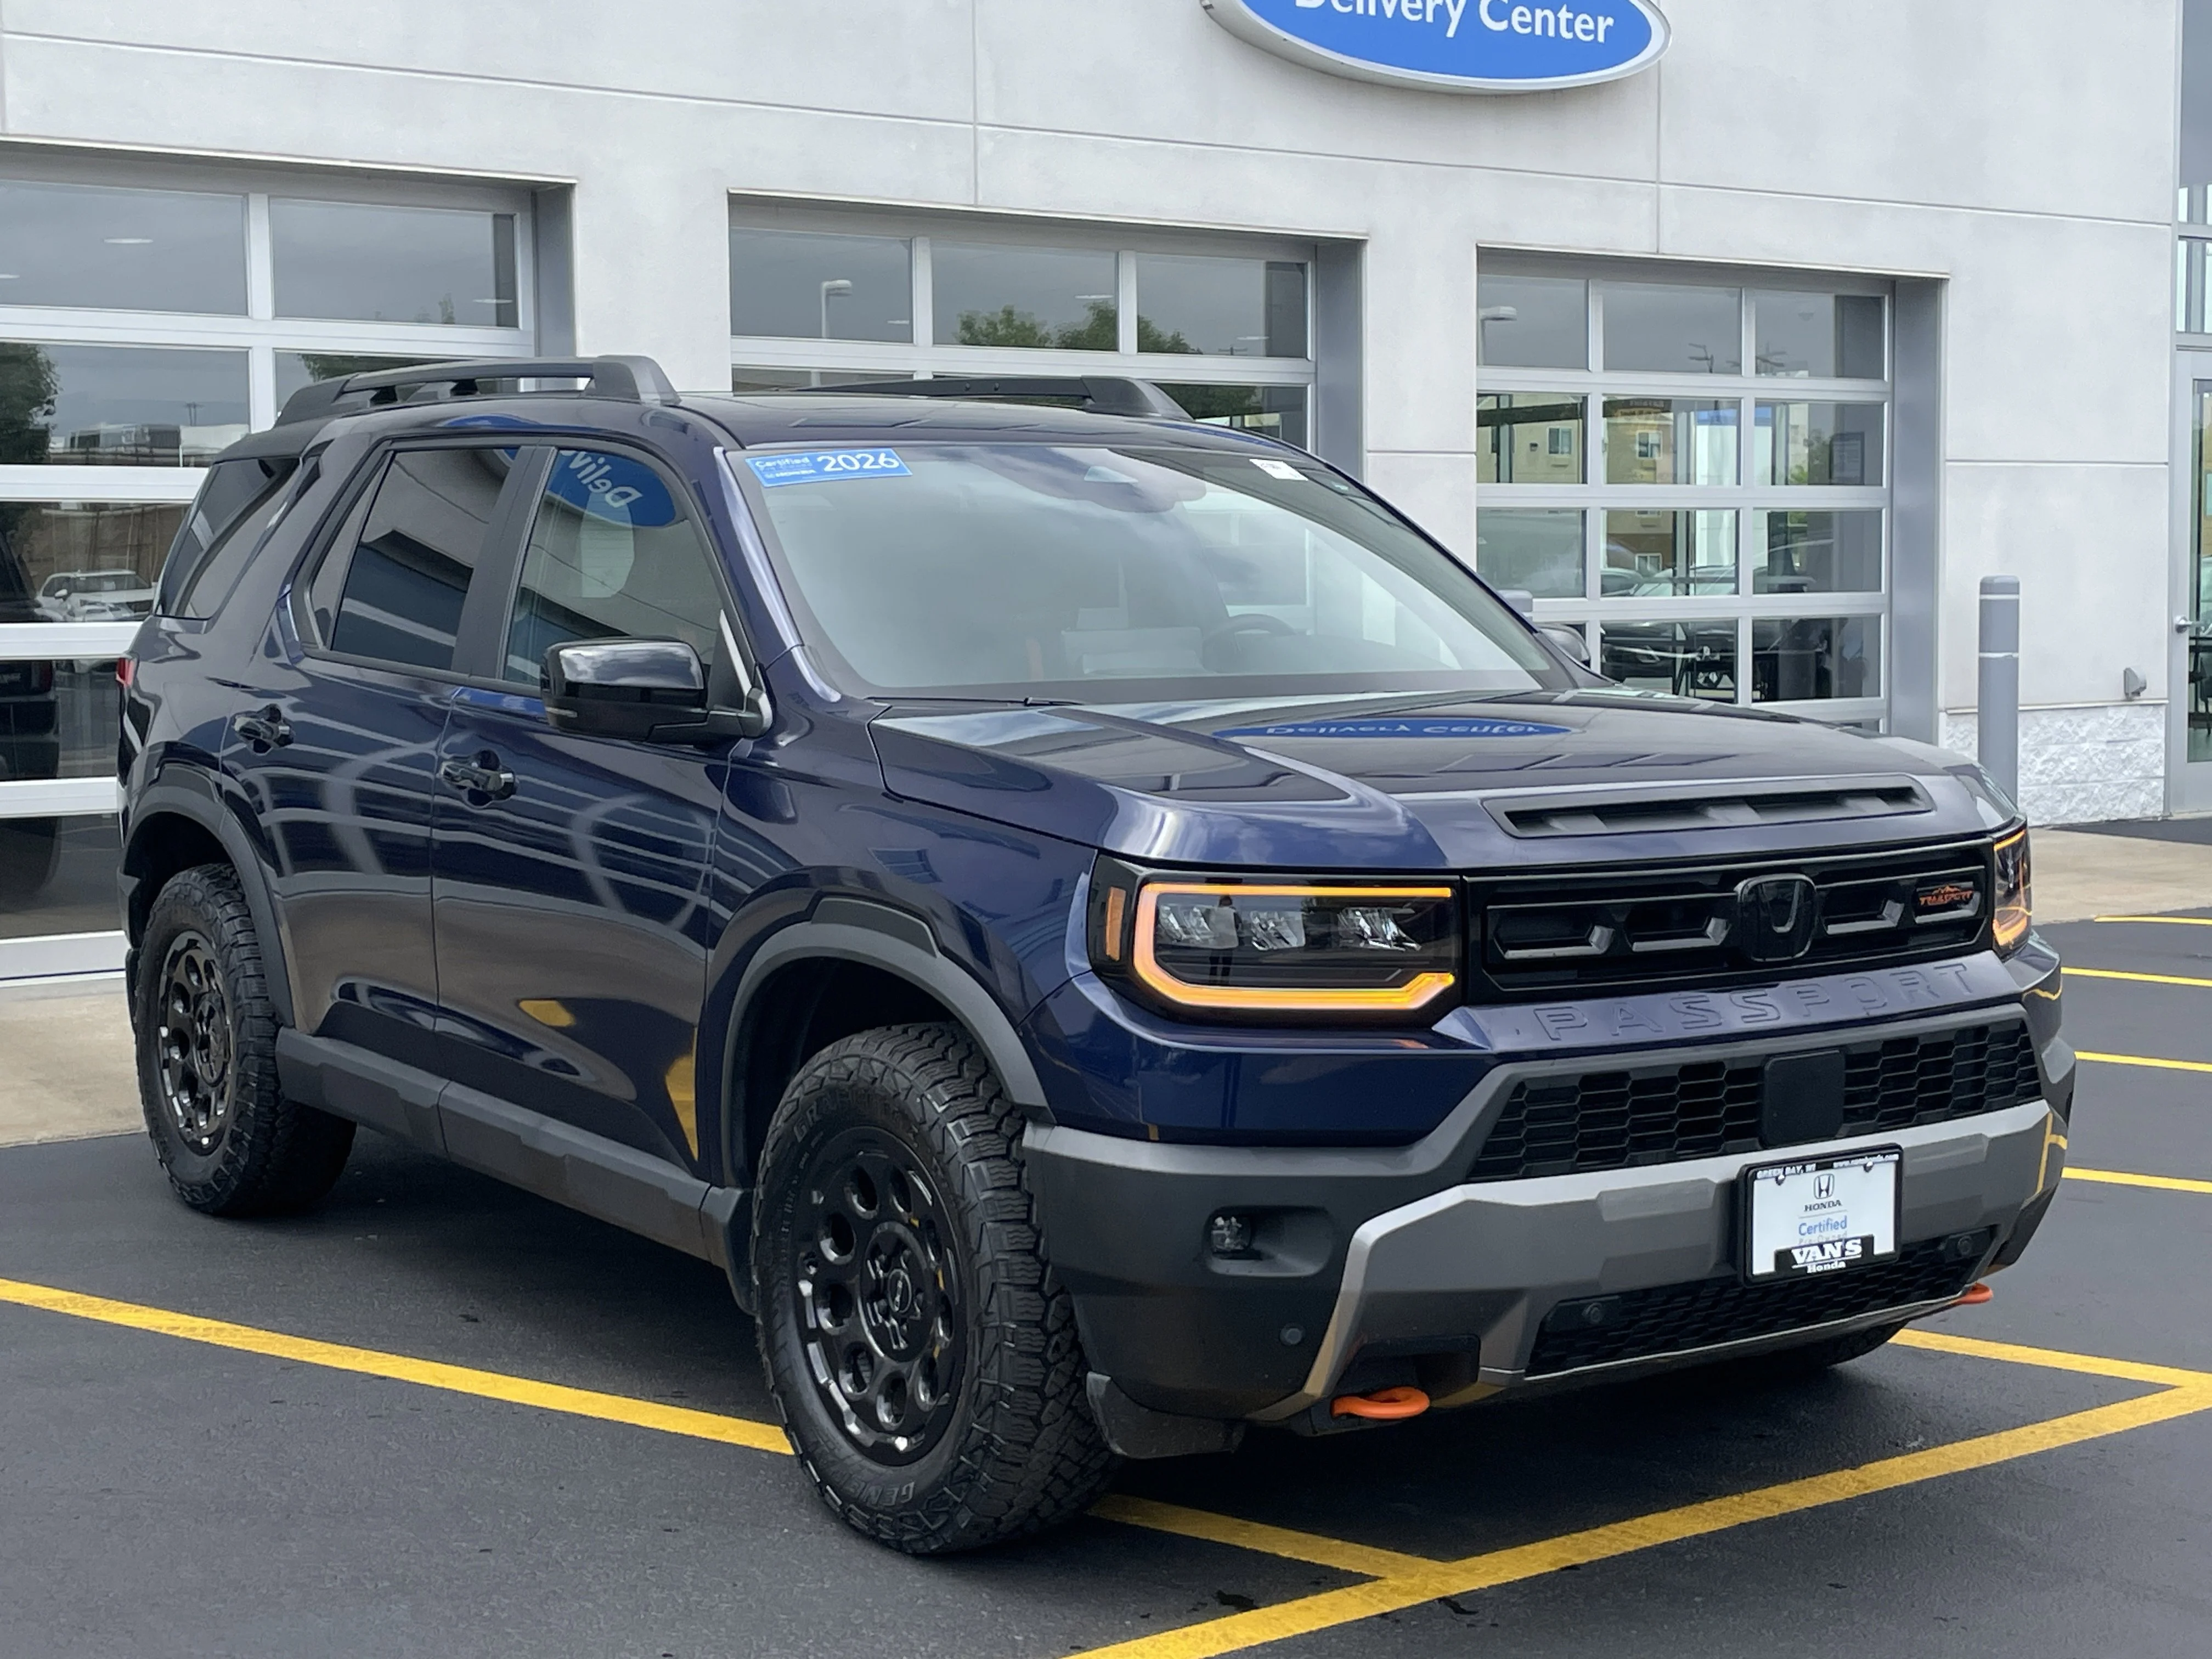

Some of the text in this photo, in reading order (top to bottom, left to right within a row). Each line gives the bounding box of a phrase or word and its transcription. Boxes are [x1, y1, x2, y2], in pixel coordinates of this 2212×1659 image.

[1295, 0, 1615, 43] every Center
[755, 456, 810, 466] Certified
[816, 452, 900, 472] 2026
[1533, 962, 1974, 1041] PASSPORT
[1804, 1199, 1842, 1211] HONDA
[1798, 1215, 1847, 1235] Certified
[1807, 1261, 1847, 1273] Honda
